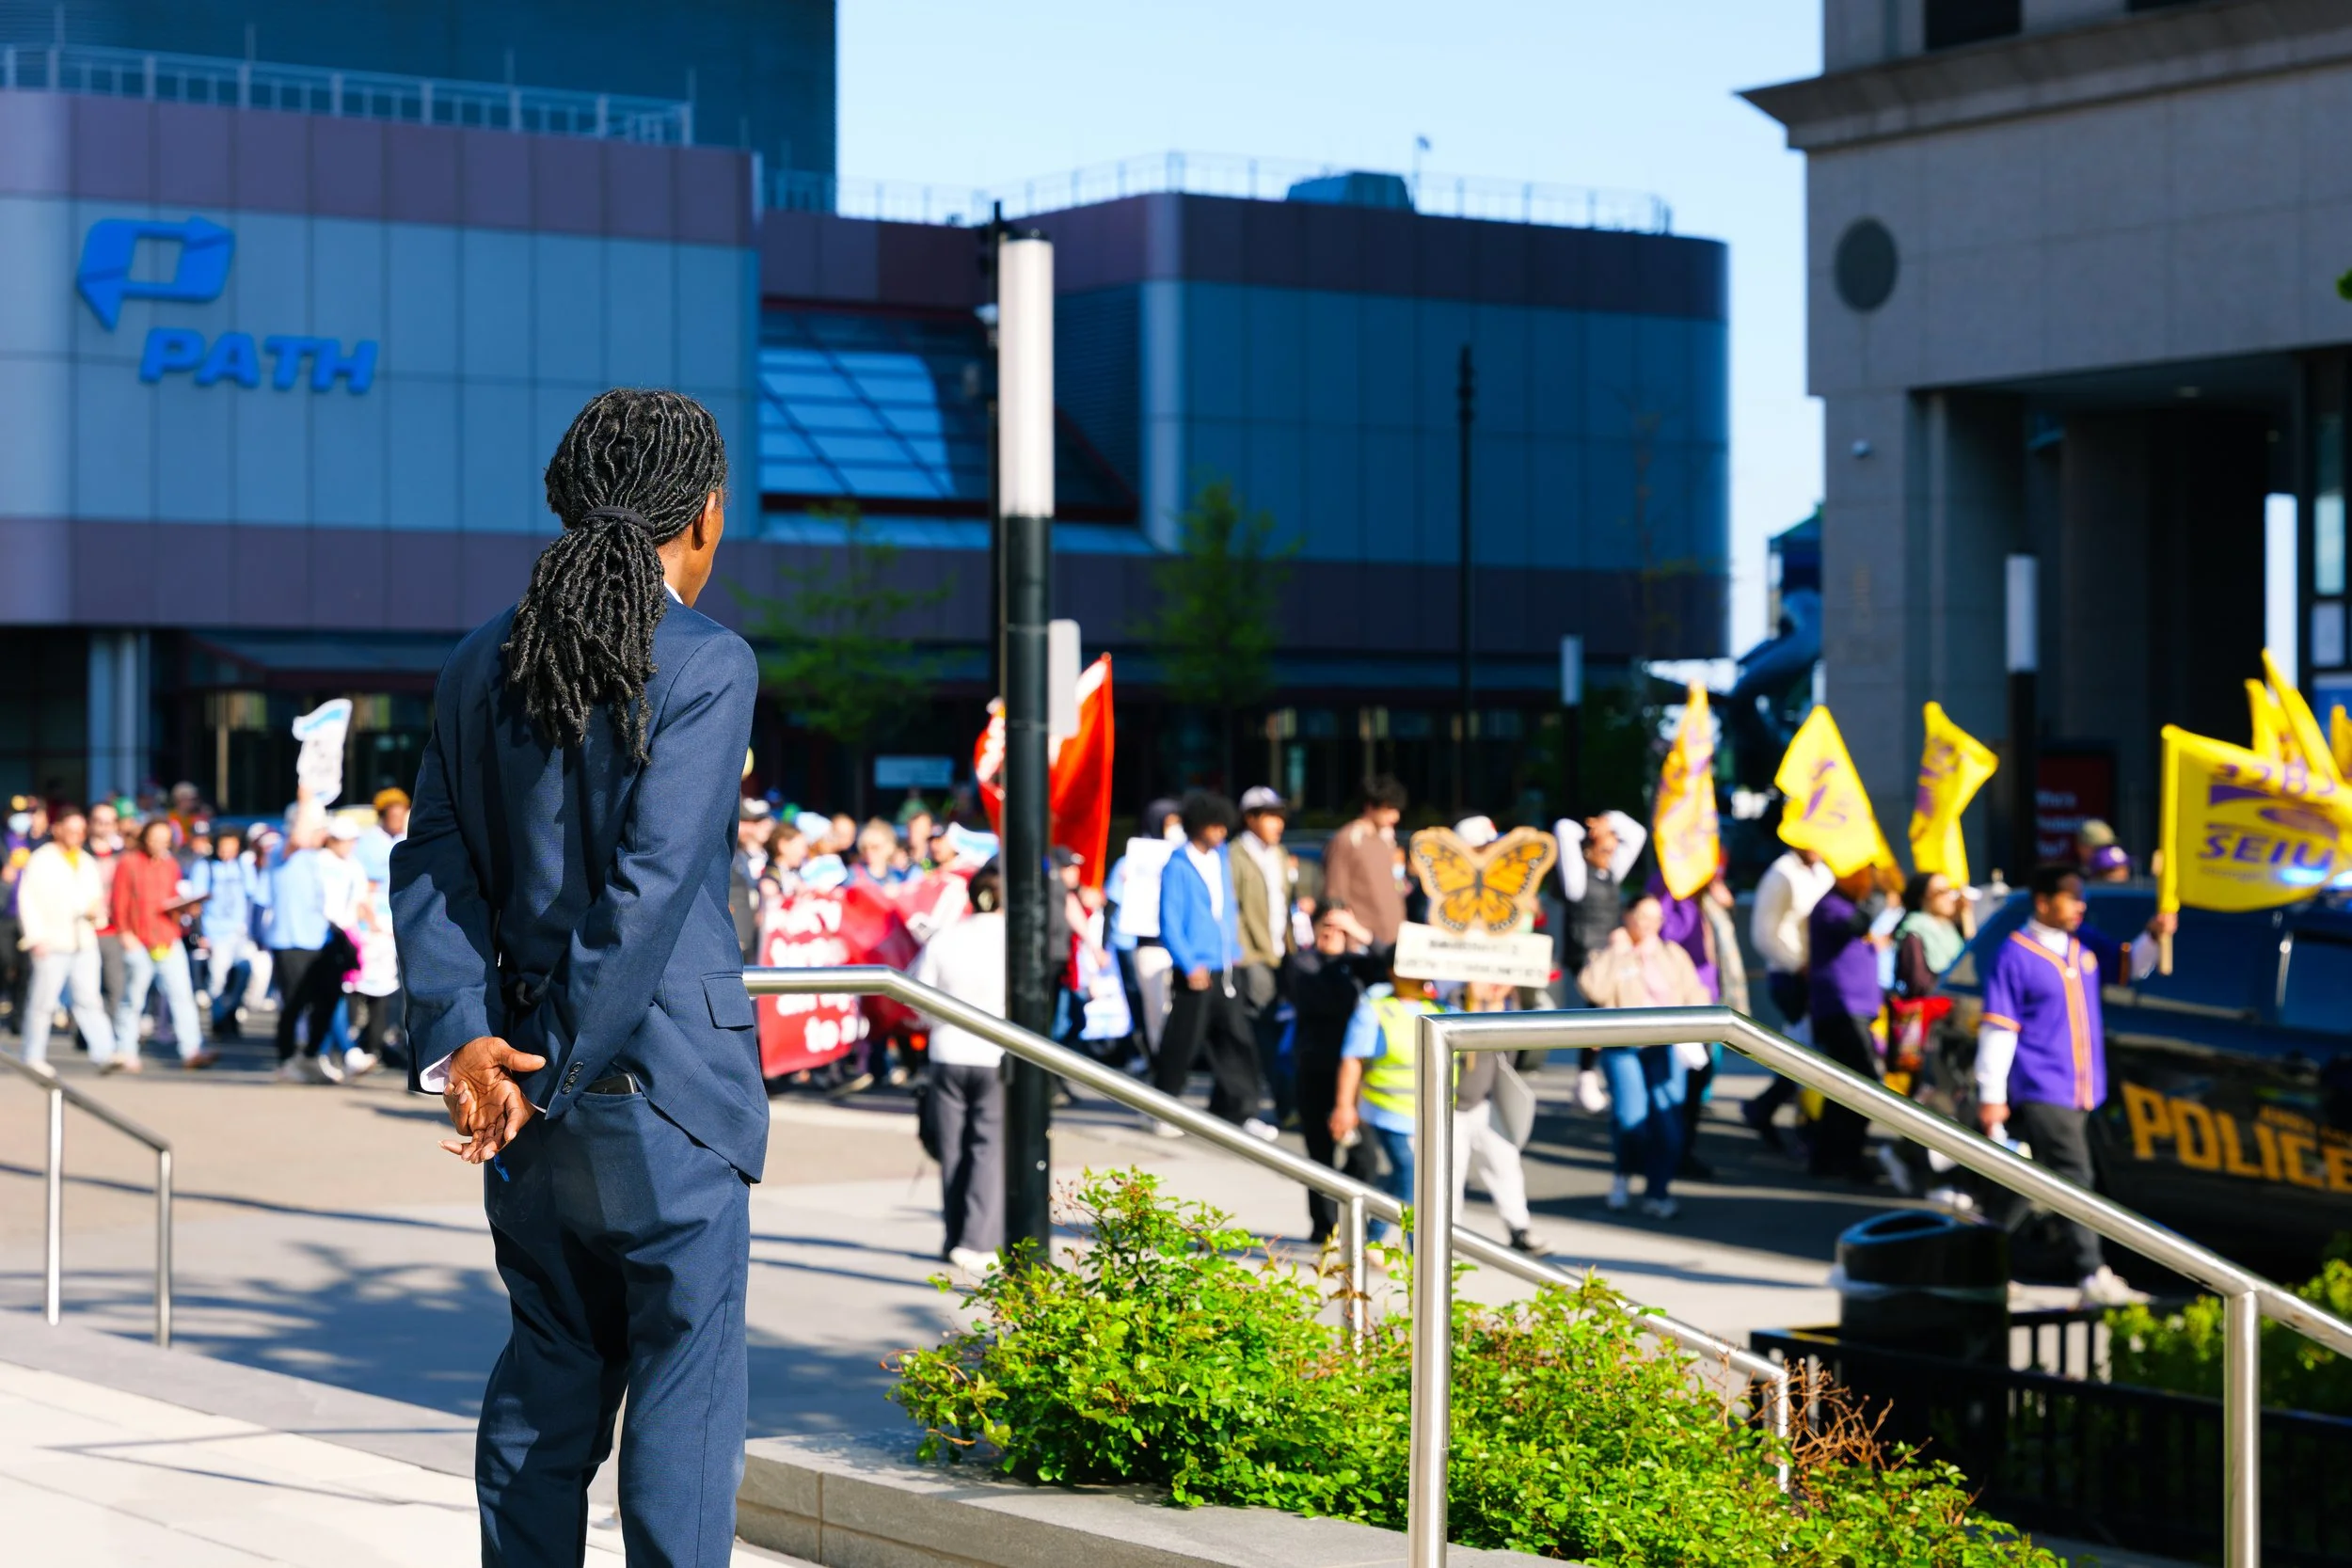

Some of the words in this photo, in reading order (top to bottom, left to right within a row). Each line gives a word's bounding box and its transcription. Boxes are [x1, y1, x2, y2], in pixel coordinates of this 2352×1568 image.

[139, 325, 379, 395] PATH
[2199, 832, 2335, 871] SEIU
[2121, 1079, 2352, 1195] POLICE
